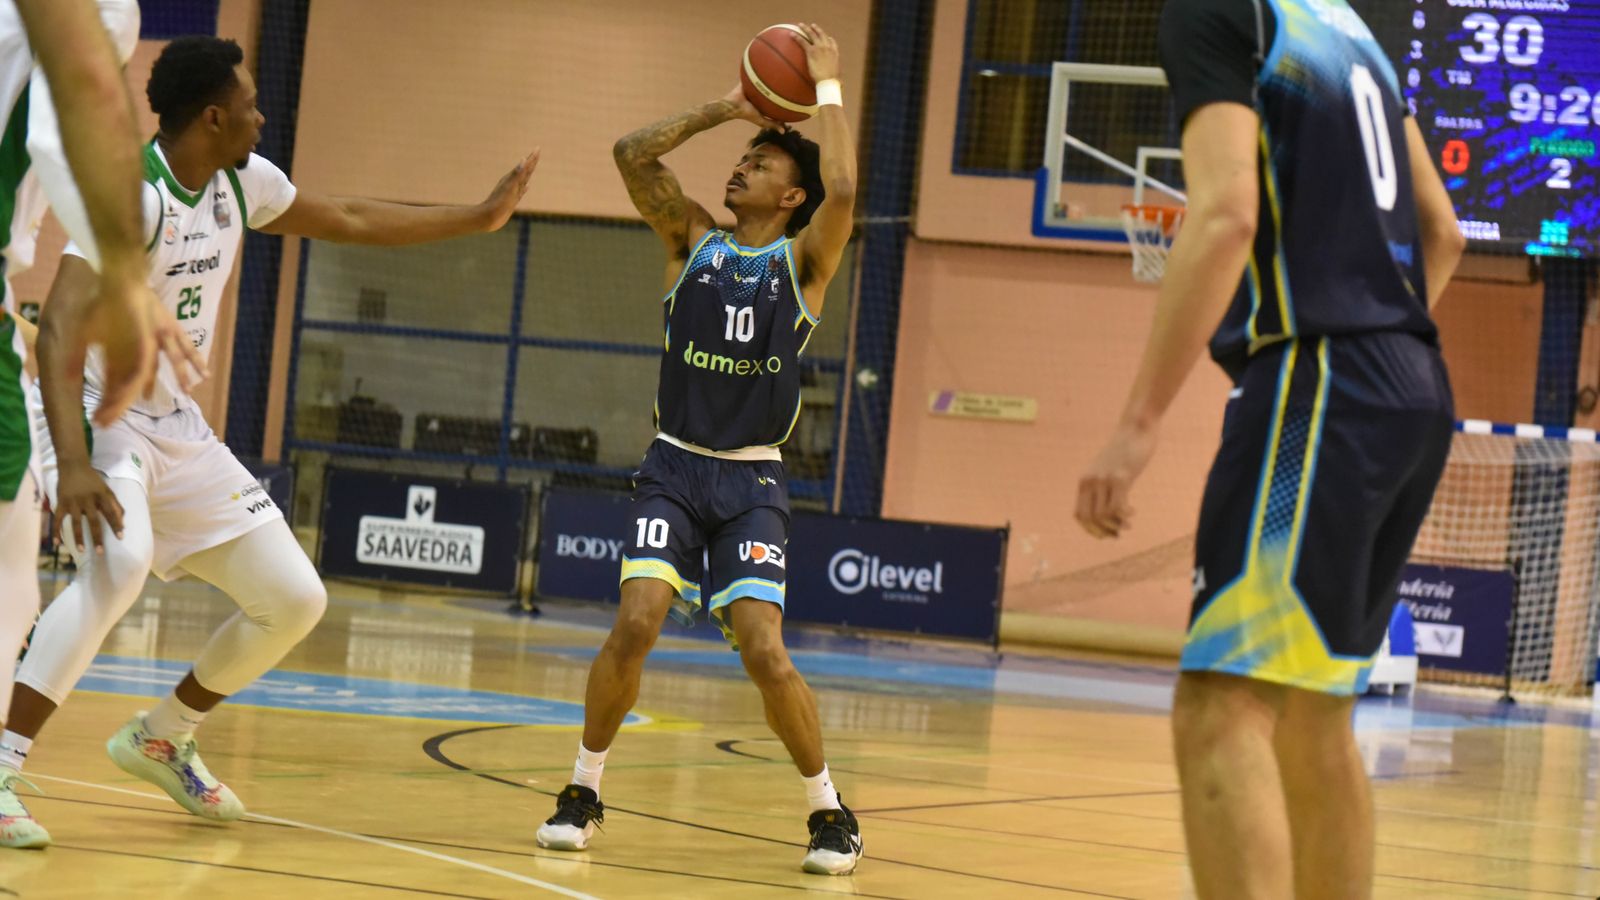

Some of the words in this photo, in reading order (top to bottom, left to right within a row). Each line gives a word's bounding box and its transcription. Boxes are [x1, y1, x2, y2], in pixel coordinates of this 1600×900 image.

[1459, 12, 1544, 66] 30
[1509, 83, 1600, 126] 9:2
[1351, 62, 1398, 211] 0
[1441, 139, 1470, 174] 0
[1545, 157, 1572, 189] 2
[176, 285, 202, 320] 25
[724, 304, 755, 343] 10
[363, 532, 474, 568] SAAVEDRA
[556, 534, 625, 562] BODY
[636, 517, 669, 549] 10
